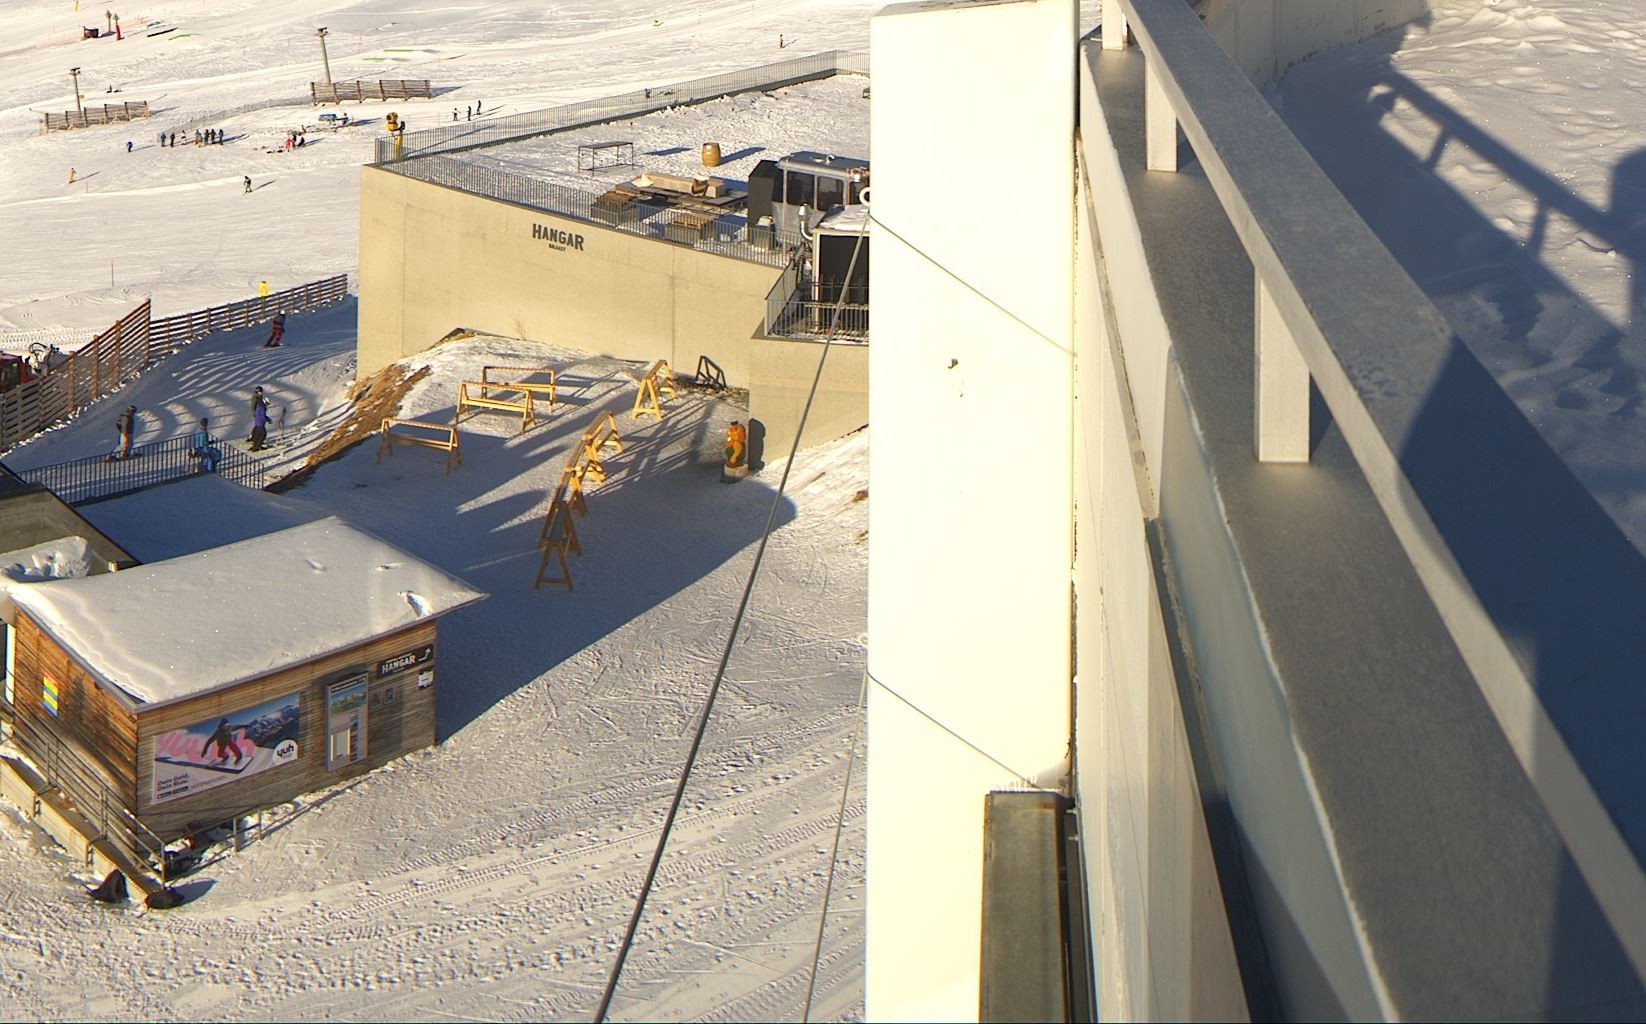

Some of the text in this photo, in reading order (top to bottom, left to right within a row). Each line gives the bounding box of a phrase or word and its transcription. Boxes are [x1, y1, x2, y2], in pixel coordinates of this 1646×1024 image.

[532, 223, 584, 251] HANGAR
[381, 655, 416, 674] HANGAR
[276, 743, 295, 758] yuh
